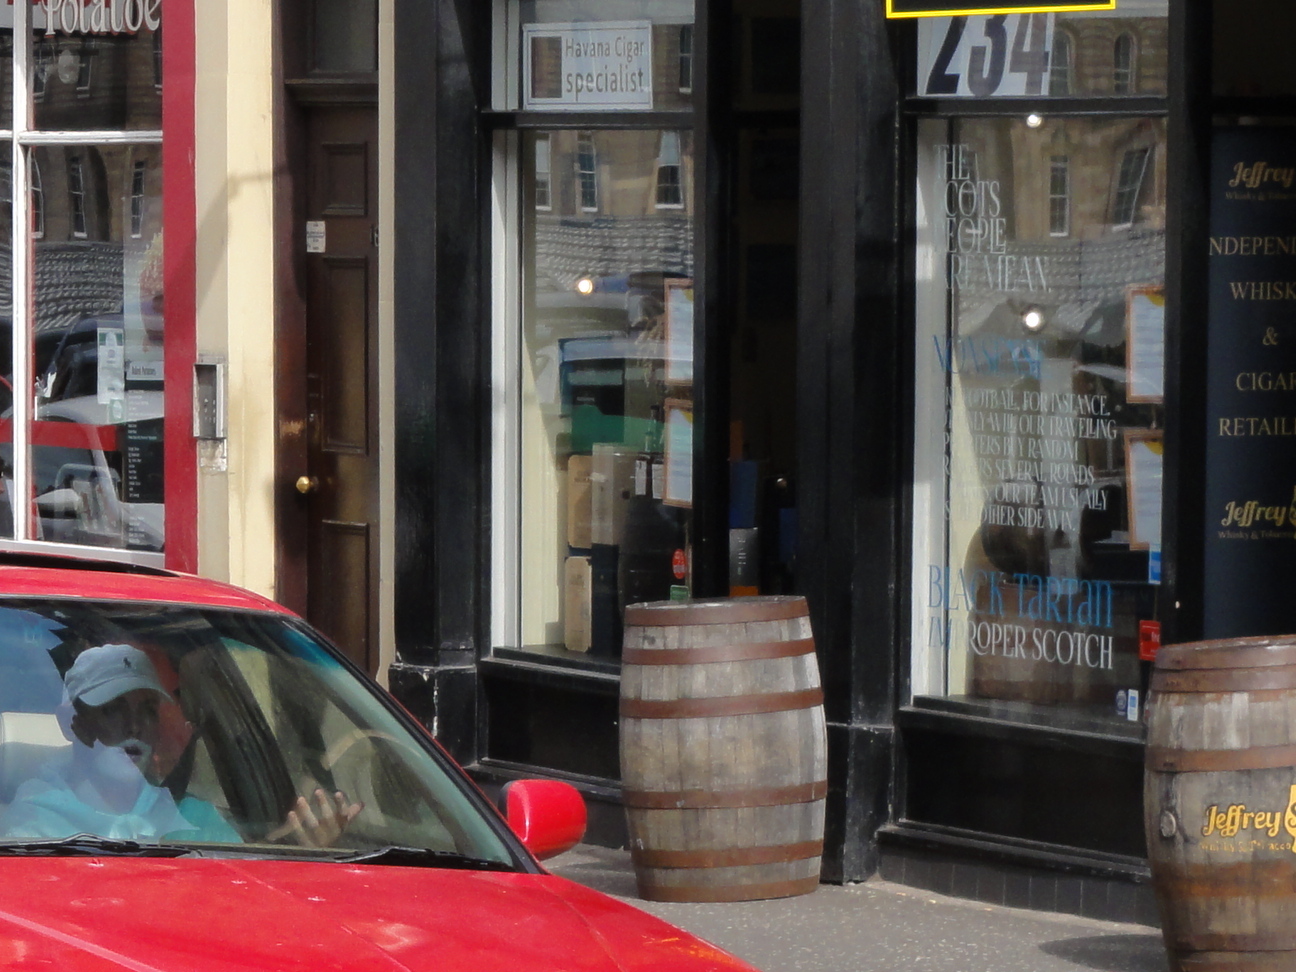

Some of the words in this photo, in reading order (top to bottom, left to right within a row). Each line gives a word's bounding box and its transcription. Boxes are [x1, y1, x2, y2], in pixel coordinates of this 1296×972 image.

[566, 38, 611, 58] Havana
[615, 36, 645, 63] Cigar
[566, 64, 644, 101] specialist
[1228, 161, 1296, 188] Jeffrey
[942, 180, 1001, 218] COTS
[943, 218, 1007, 255] EOPLE
[1262, 326, 1279, 346] &
[964, 387, 1020, 411] OOTBALL,
[1022, 391, 1048, 413] FOR
[1019, 414, 1045, 436] OUR
[1049, 416, 1117, 440] TRAVELLING
[1218, 418, 1296, 436] RETAIL
[1028, 438, 1079, 461] RANDOM
[995, 459, 1047, 483] SEVERAL
[1049, 463, 1095, 486] ROUNDS
[995, 482, 1021, 503] OUR
[1017, 507, 1044, 529] SIDE
[1221, 501, 1287, 527] Jeffrey
[927, 564, 1005, 616] BLACK
[1032, 627, 1114, 670] SCOTCH
[1203, 804, 1282, 837] Jeffrey
